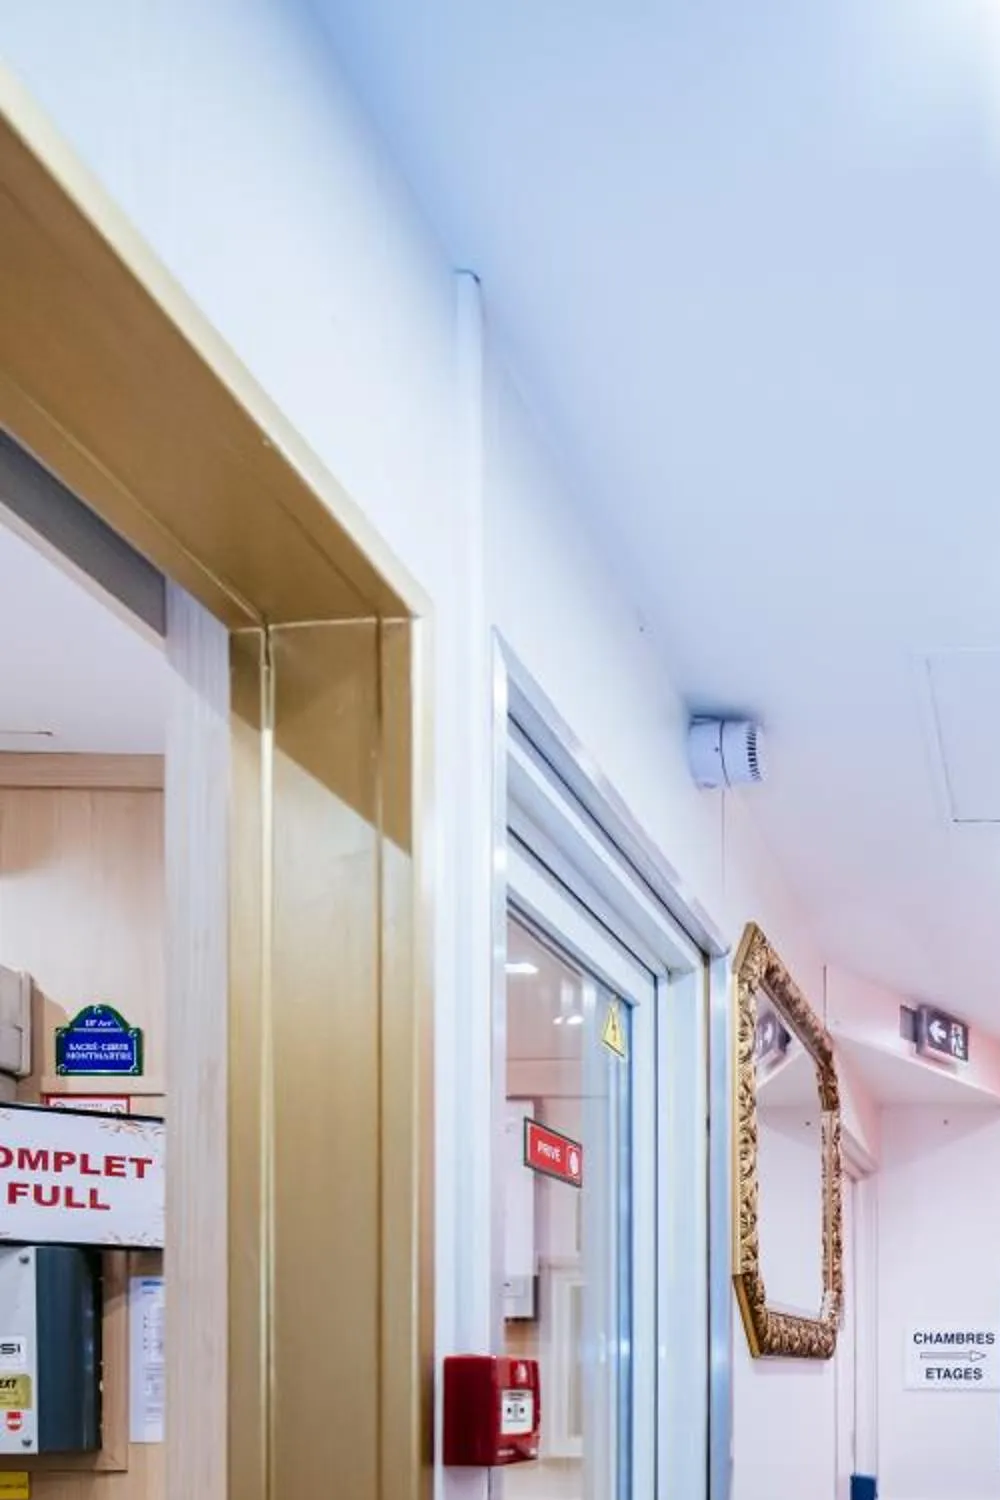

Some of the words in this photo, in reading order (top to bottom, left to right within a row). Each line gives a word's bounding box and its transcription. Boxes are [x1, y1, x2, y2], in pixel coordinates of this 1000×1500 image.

[8, 1182, 111, 1211] FULL
[913, 1331, 996, 1345] CHAMBRES
[925, 1367, 983, 1381] ETAGES
